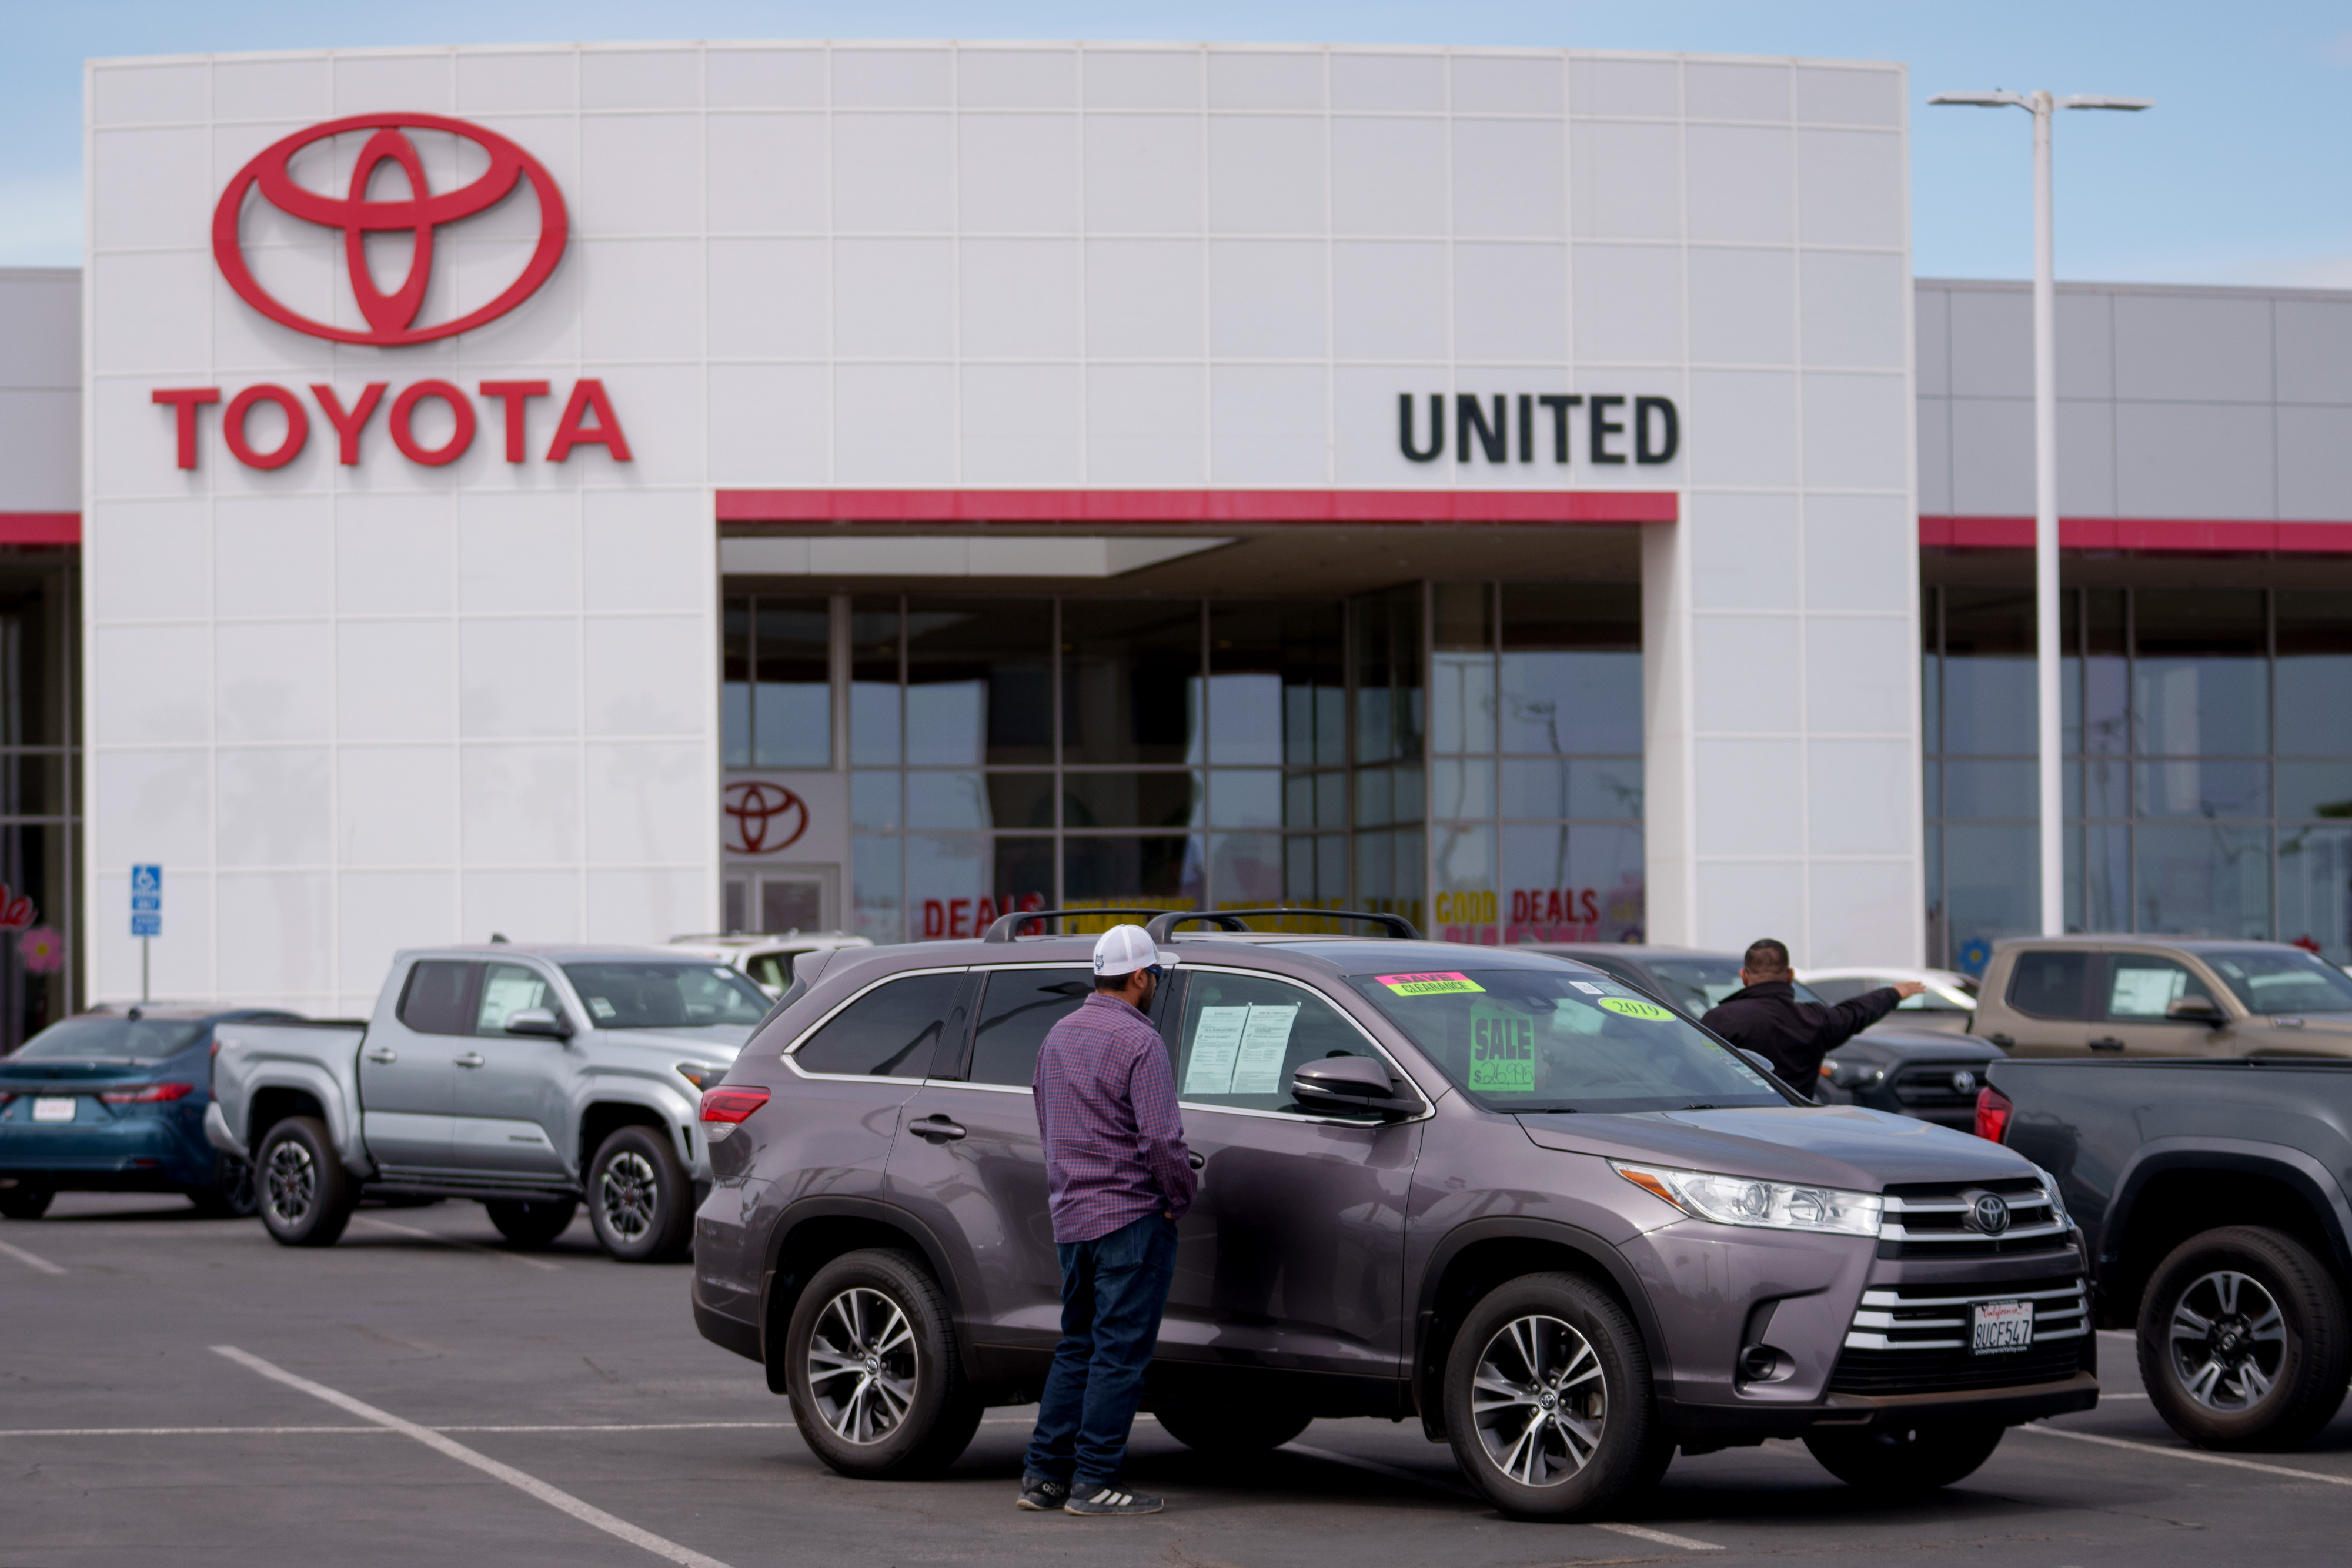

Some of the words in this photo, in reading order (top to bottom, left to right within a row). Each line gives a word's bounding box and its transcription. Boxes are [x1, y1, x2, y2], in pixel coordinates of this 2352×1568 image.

[152, 378, 633, 470] TOYOTA
[1398, 393, 1680, 464] UNITED
[1436, 890, 1497, 924] GOOD
[1512, 887, 1600, 924] DEALS
[1392, 974, 1455, 984] SAVE
[1402, 981, 1470, 993] CLEARANCE
[1612, 1001, 1660, 1016] 2019
[1475, 1018, 1532, 1061] SALE
